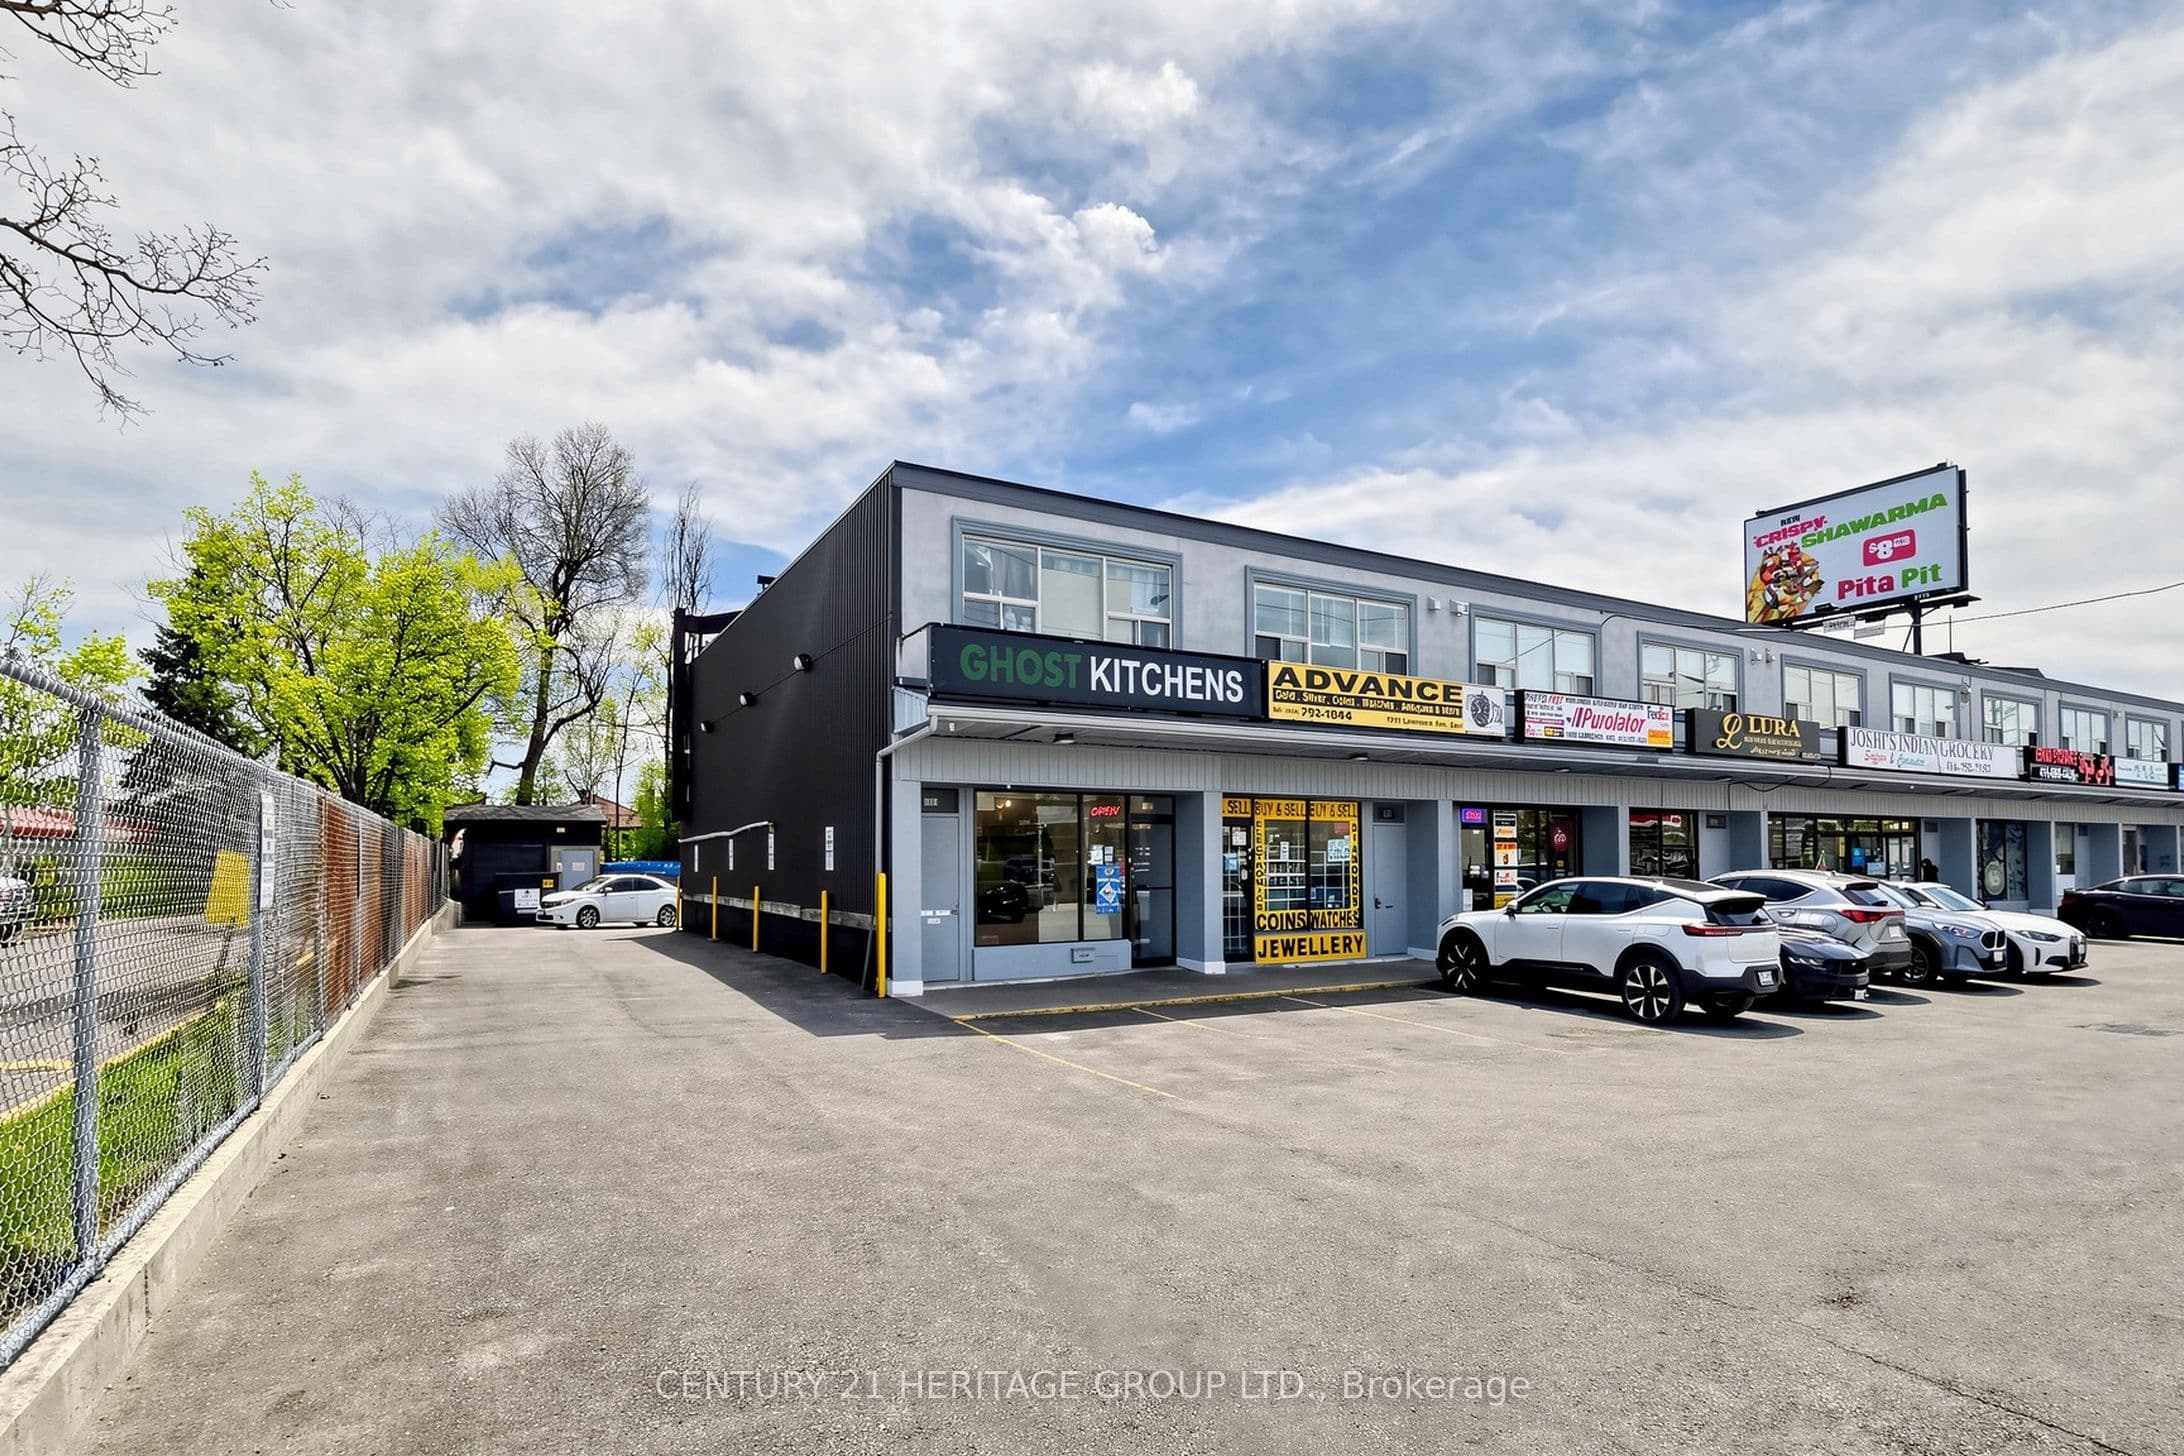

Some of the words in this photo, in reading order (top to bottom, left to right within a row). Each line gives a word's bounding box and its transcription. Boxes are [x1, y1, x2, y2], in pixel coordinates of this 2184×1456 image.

[1755, 515, 1826, 548] CRISPY
[1801, 493, 1948, 549] SHAWARMA
[1837, 575, 1894, 600] Pita
[1901, 563, 1942, 588] Pit
[960, 644, 1081, 688] GHOST
[1090, 656, 1243, 702] KITCHENS
[1273, 666, 1463, 703] ADVANCE
[1581, 707, 1647, 733] Purolator
[1747, 716, 1800, 737] LURA
[1899, 735, 1938, 756] INDIAN
[1938, 741, 1995, 761] GROCERY
[1090, 805, 1120, 817] OPEN
[1227, 800, 1249, 815] SELL
[1255, 801, 1273, 815] BUY
[1284, 802, 1306, 817] SELL
[1256, 912, 1306, 931] COINS
[1310, 910, 1359, 929] WATCHES
[1258, 934, 1363, 959] JEWELLERY
